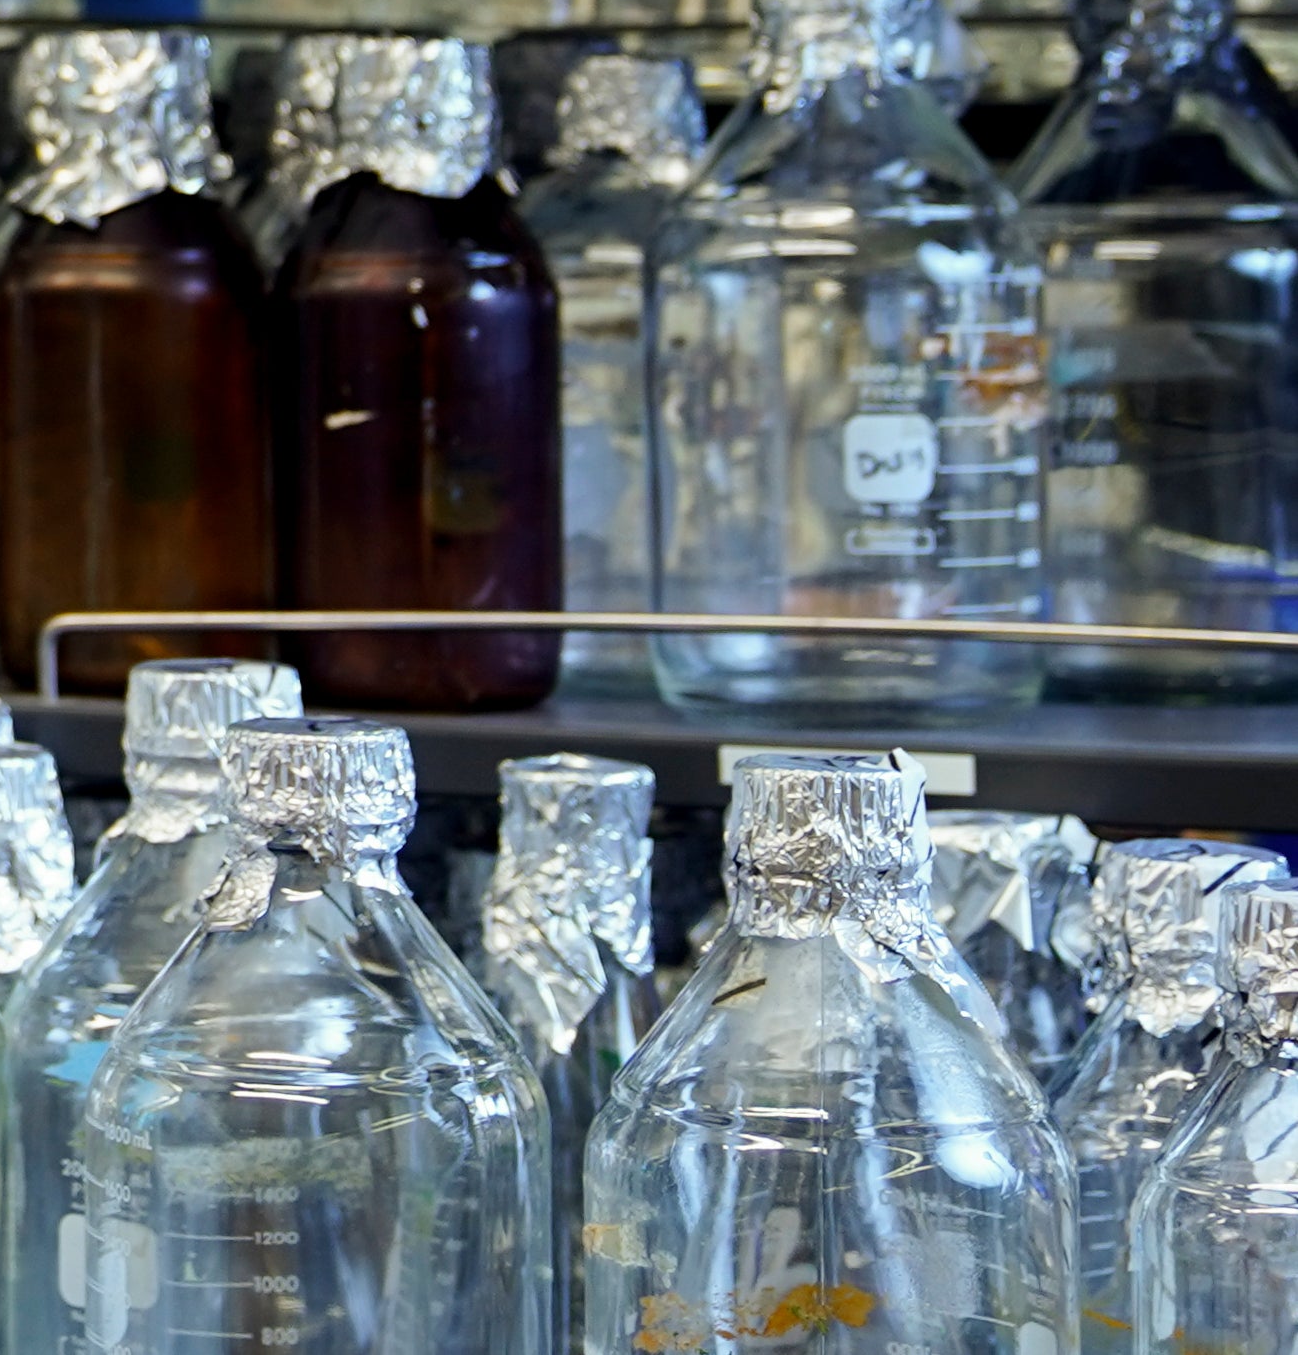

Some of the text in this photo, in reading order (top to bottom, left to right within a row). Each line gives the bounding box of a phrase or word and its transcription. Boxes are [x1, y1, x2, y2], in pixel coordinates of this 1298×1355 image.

[253, 1230, 300, 1245] 1200
[252, 1274, 300, 1294] 1000
[261, 1326, 300, 1346] 800
